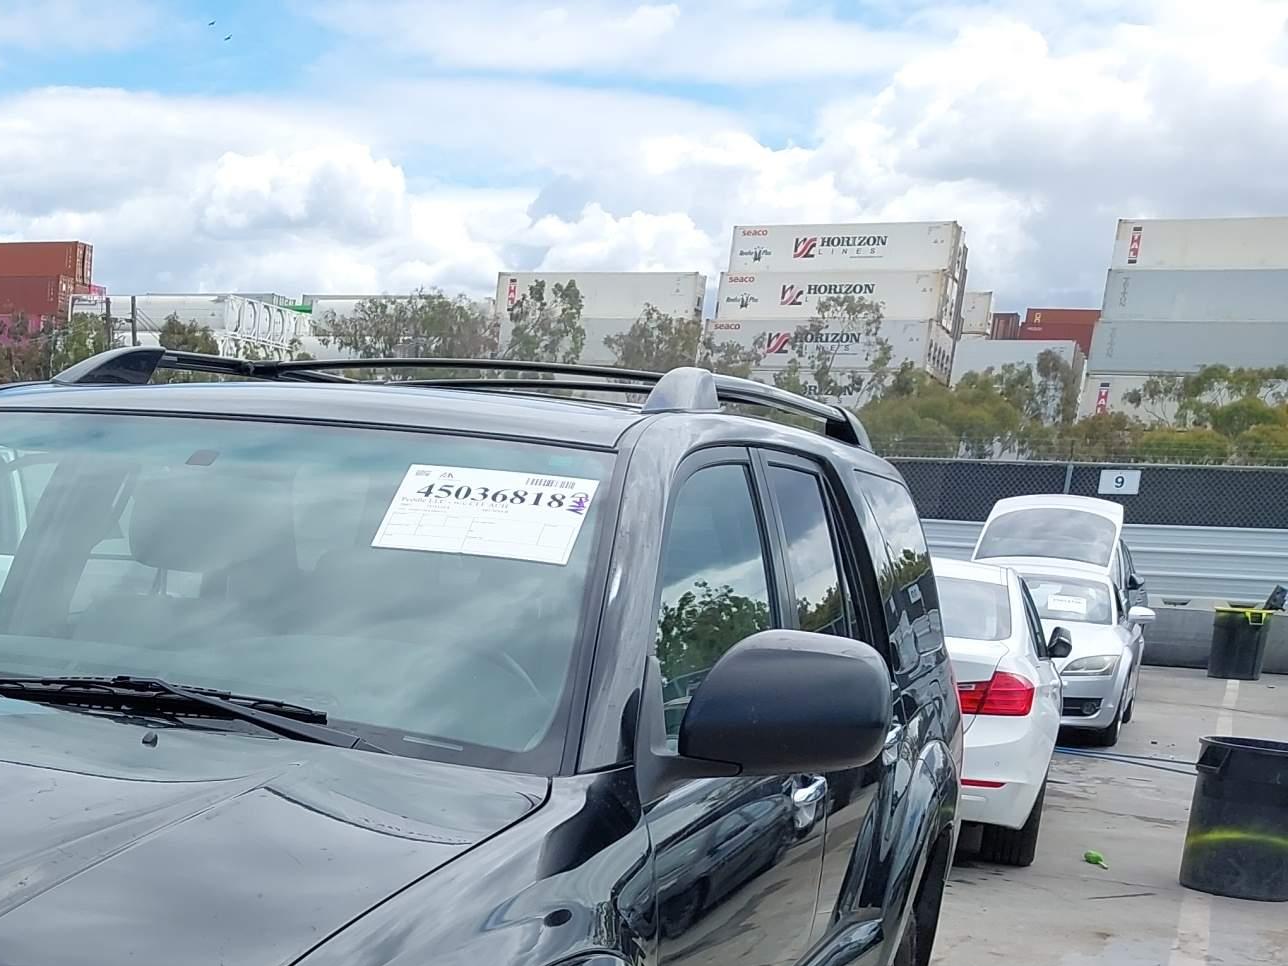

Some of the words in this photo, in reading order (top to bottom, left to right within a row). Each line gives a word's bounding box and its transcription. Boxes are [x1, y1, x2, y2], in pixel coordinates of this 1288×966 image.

[820, 235, 888, 247] HORIZON
[807, 284, 875, 295] HORIZON
[1114, 475, 1125, 489] 9
[416, 482, 566, 508] 45036818
